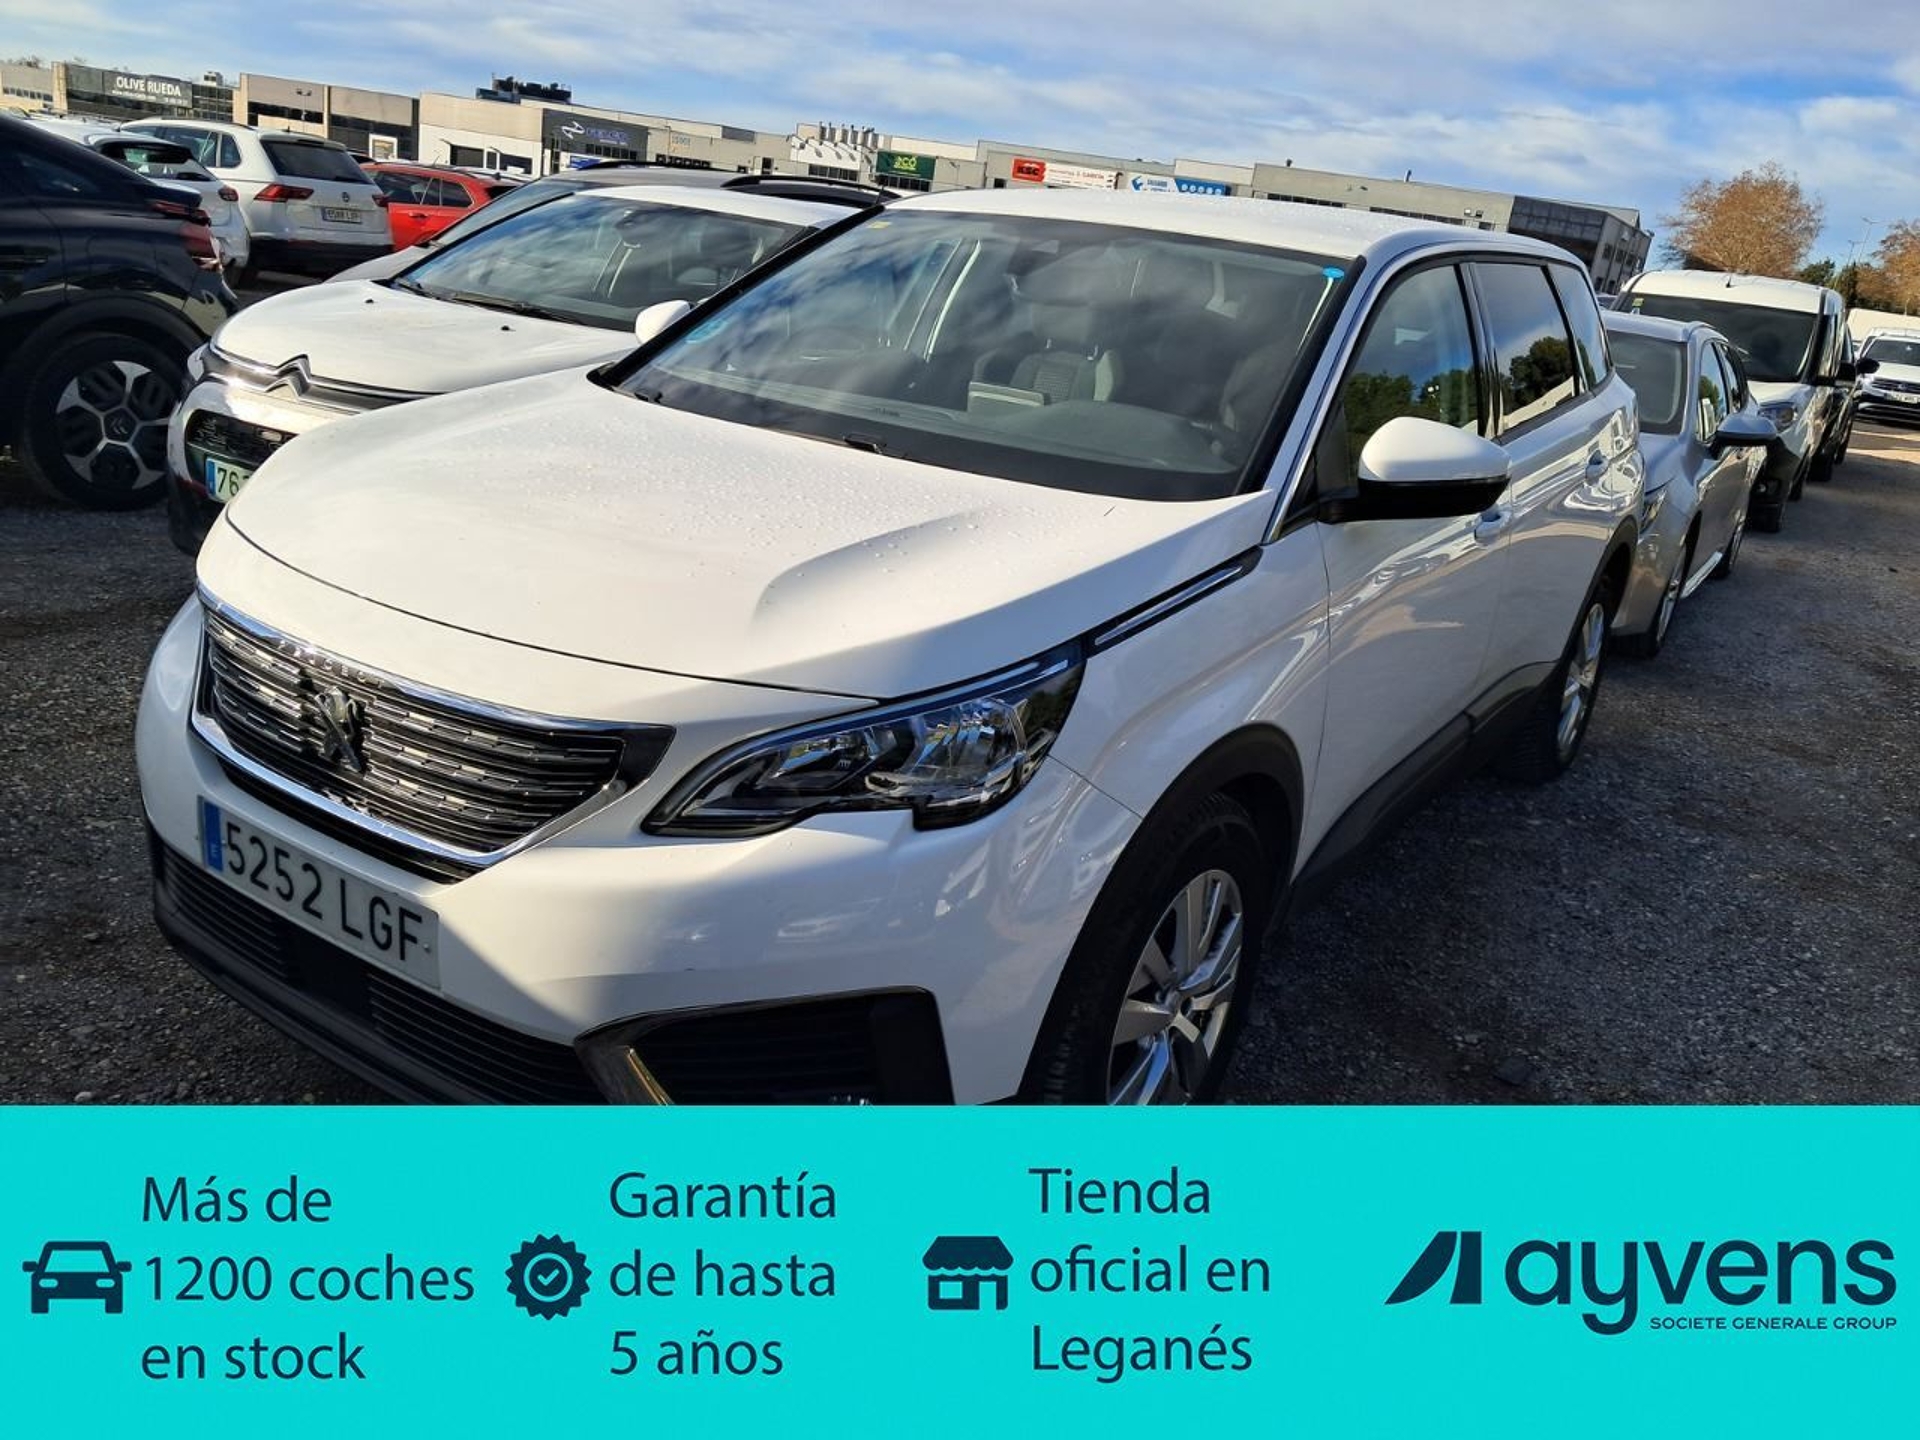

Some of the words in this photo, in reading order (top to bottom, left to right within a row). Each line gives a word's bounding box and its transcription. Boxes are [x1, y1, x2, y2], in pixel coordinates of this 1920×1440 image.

[116, 76, 146, 92] OLIVE
[147, 80, 182, 97] RUEDA
[217, 467, 250, 497] 76
[227, 822, 323, 921] 5252
[340, 878, 423, 962] LGF
